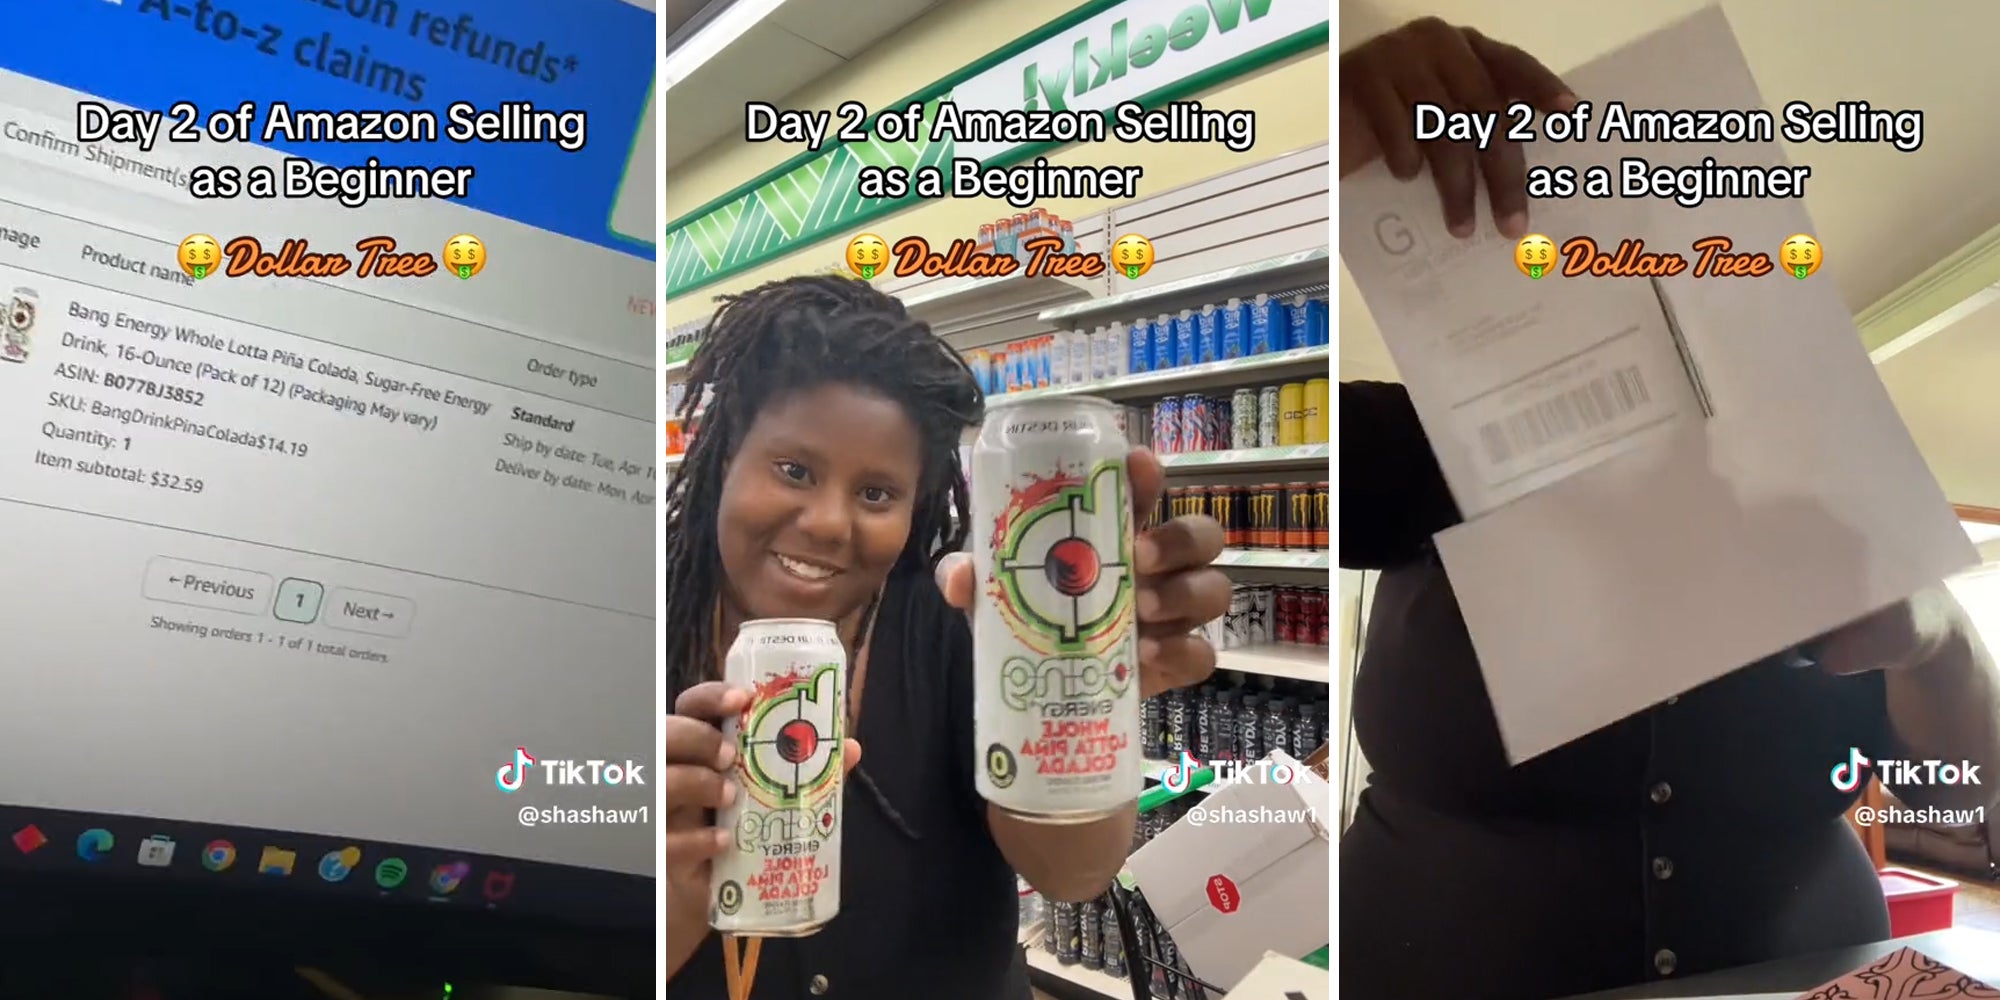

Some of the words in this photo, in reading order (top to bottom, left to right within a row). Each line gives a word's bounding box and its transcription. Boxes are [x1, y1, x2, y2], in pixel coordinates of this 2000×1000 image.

[138, 0, 283, 57] A-to-z
[294, 31, 427, 102] claims
[3, 120, 79, 158] Confirm
[84, 143, 188, 188] Shipment(s
[0, 227, 41, 249] mage
[1373, 212, 1416, 257] G
[81, 244, 146, 275] Product
[150, 264, 195, 287] name
[53, 362, 100, 384] ASIN:
[68, 301, 109, 328] Bang
[114, 312, 171, 341] Energy
[175, 326, 224, 350] Whole
[228, 339, 267, 361] Lotta
[271, 348, 304, 369] Piña
[308, 357, 360, 384] Colada,
[364, 371, 441, 401] Sugar-Free
[443, 390, 492, 415] Energy
[526, 358, 569, 379] Order
[568, 369, 598, 388] type
[61, 331, 108, 356] Drink,
[116, 344, 193, 374] 16-Ounce
[196, 361, 237, 384] (Pack
[240, 375, 258, 388] of
[263, 376, 286, 398] 12)
[289, 382, 367, 416] (Packaging
[370, 402, 400, 423] May
[403, 413, 439, 432] vary)
[48, 391, 87, 412] SKU:
[90, 400, 309, 458] BangDrinkPinaColada$14.19
[511, 405, 575, 433] Standard
[41, 420, 117, 450] Quantity:
[122, 437, 132, 451] 1
[502, 432, 533, 453] Ship
[535, 439, 552, 458] by
[34, 449, 72, 470] Item
[76, 458, 148, 484] subtotal:
[149, 471, 204, 494] $32.59
[494, 458, 541, 480] Deliver
[543, 469, 561, 487] by
[183, 574, 255, 600] Previous
[295, 592, 305, 608] 1
[343, 601, 380, 621] Next
[150, 616, 208, 637] Showing
[210, 627, 253, 643] orders
[257, 632, 265, 644] 1
[278, 636, 286, 647] 1
[287, 636, 304, 650] of
[306, 639, 314, 651] 1
[316, 641, 346, 657] total
